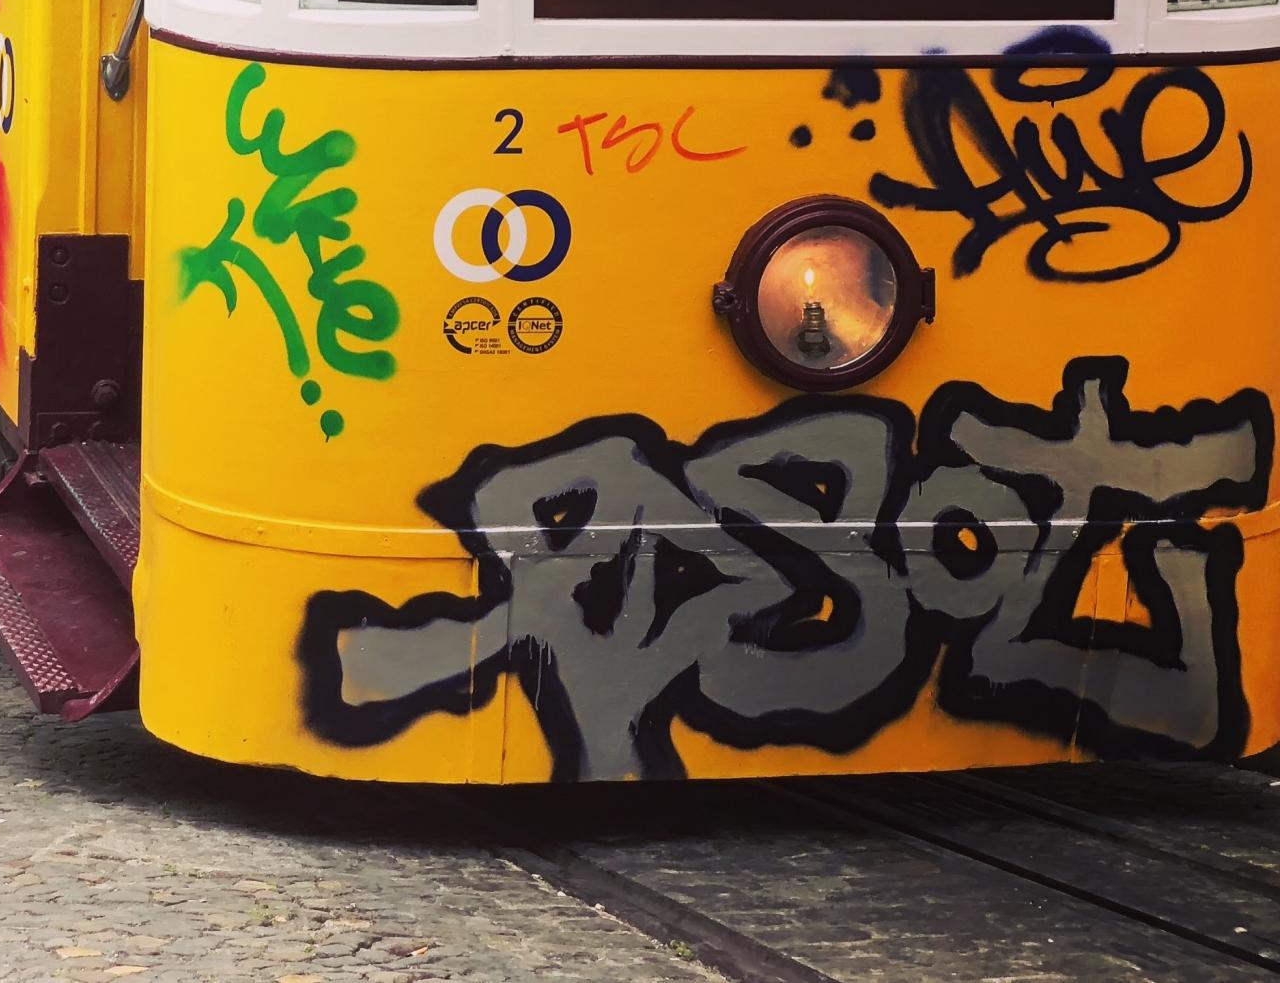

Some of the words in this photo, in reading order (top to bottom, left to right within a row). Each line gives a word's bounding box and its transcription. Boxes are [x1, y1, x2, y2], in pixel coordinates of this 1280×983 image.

[493, 108, 524, 155] 2
[454, 320, 491, 334] apcer
[518, 320, 552, 332] IQNet
